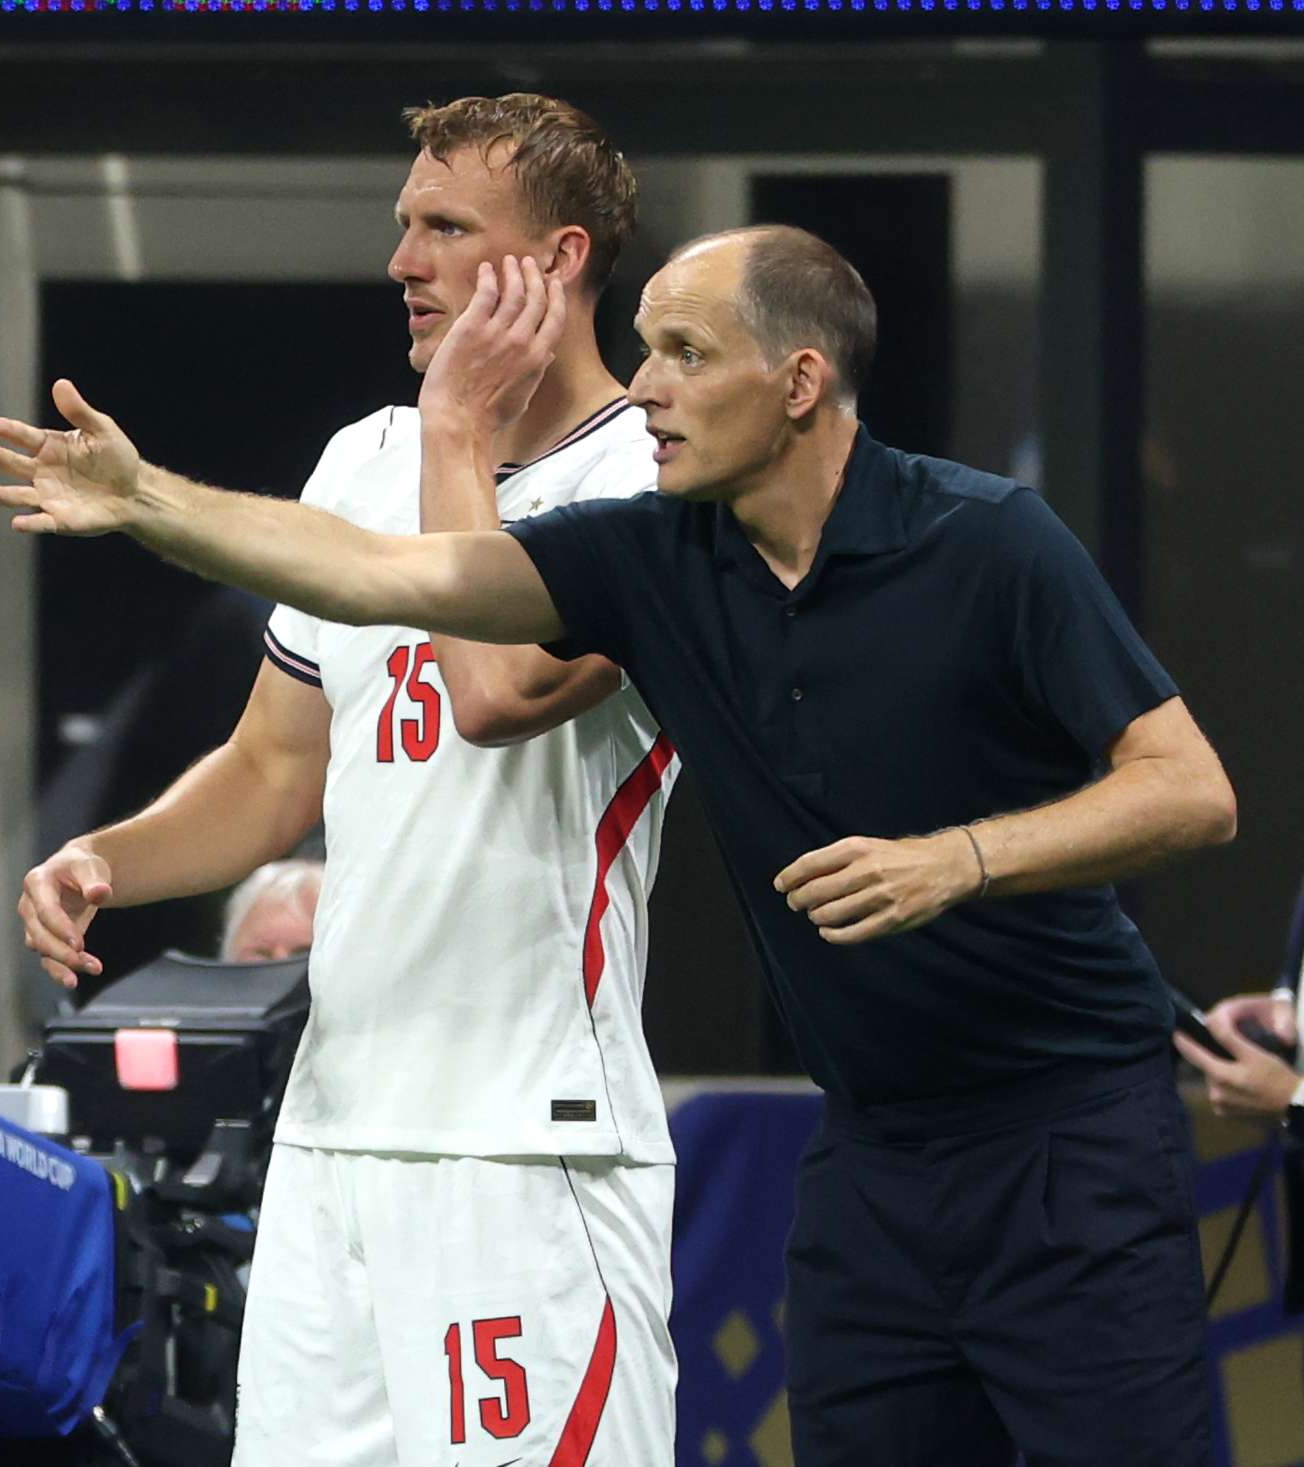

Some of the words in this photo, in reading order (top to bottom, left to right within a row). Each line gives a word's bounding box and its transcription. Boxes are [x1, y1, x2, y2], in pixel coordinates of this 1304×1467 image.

[376, 641, 441, 763] 15
[5, 1134, 48, 1180] WORLD
[48, 1157, 75, 1192] CUP
[444, 1315, 531, 1445] 15
